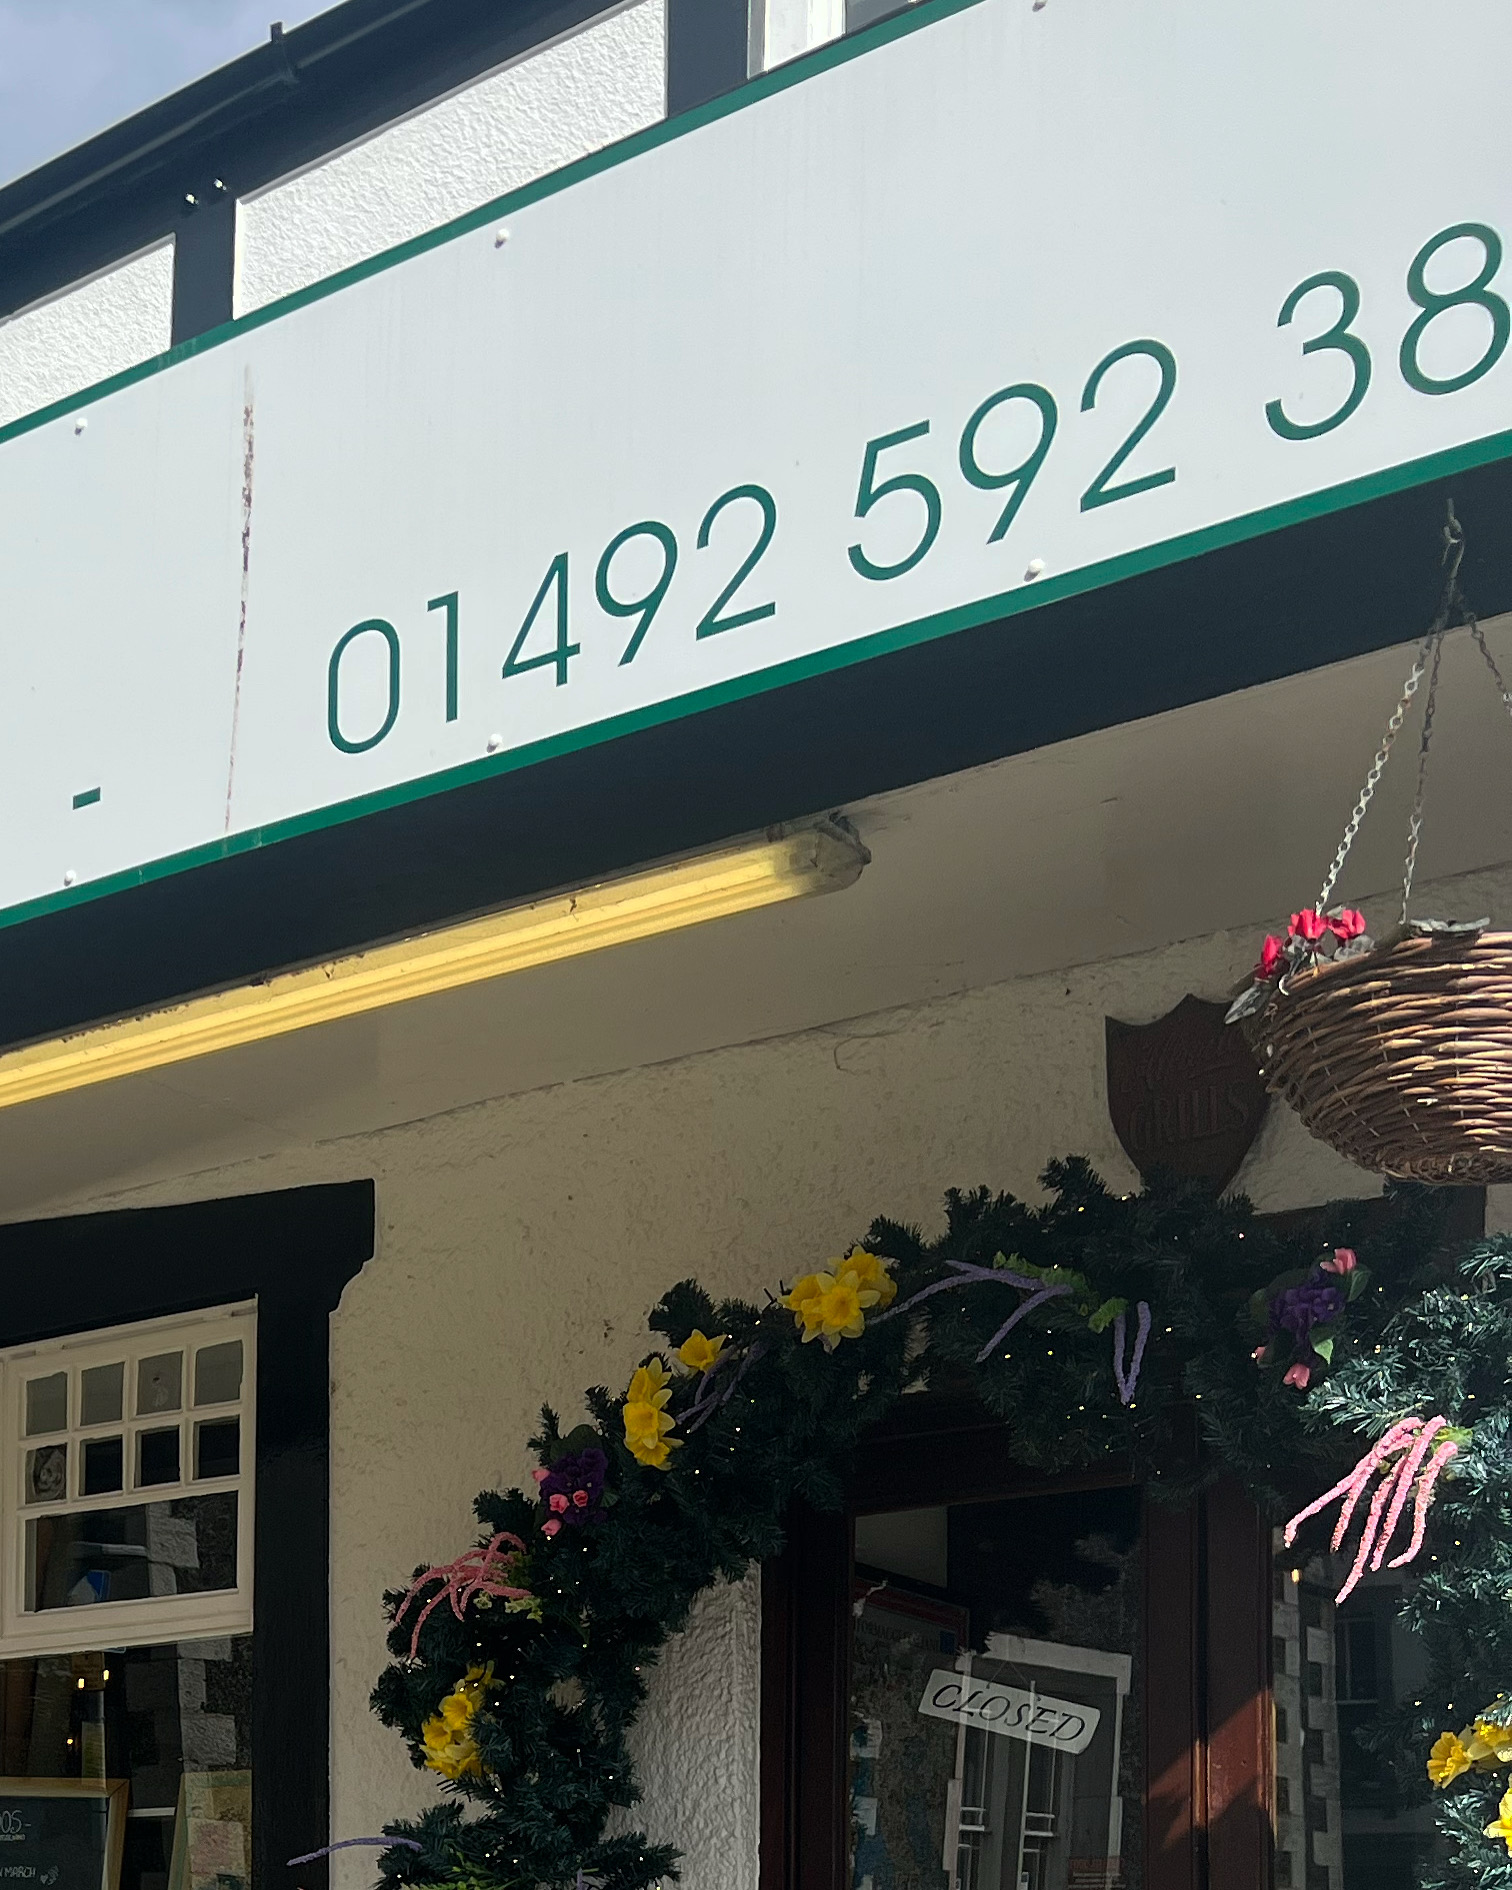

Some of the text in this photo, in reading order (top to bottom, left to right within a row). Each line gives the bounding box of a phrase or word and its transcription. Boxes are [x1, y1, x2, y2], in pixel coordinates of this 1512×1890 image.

[327, 484, 778, 755] 01492
[847, 339, 1177, 582] 592
[1265, 222, 1510, 441] 38
[932, 1684, 1085, 1741] CLOSED
[5, 1866, 36, 1878] MARCH
